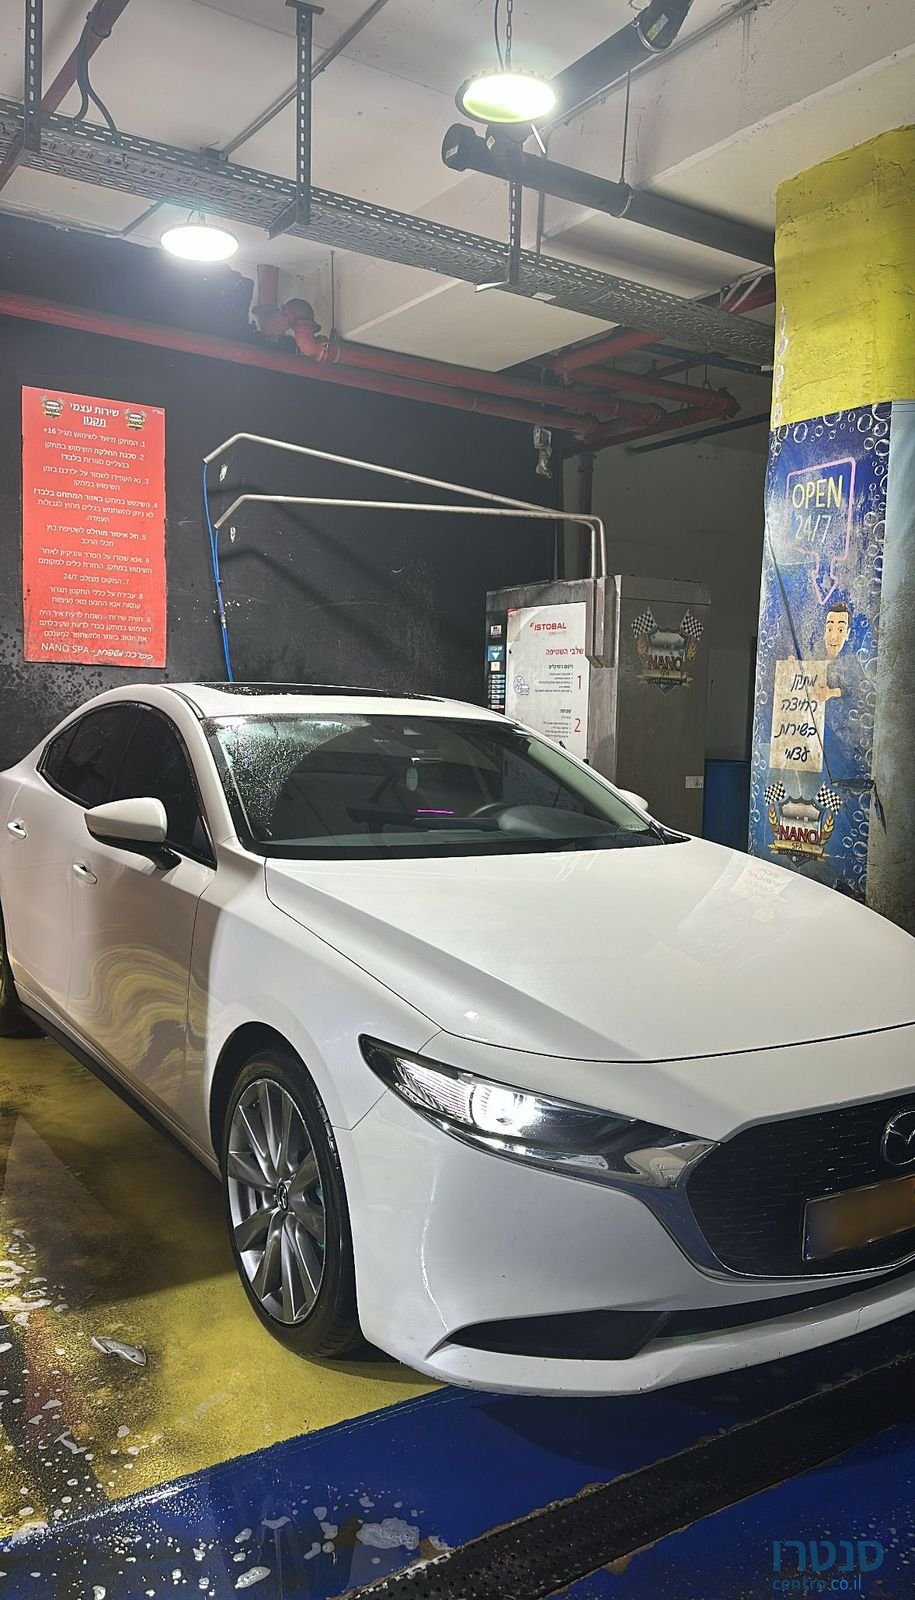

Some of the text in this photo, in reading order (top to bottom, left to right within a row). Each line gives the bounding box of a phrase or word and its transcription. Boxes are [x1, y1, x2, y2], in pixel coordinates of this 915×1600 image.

[792, 474, 843, 509] OPEN
[795, 514, 832, 543] 24/7
[534, 622, 567, 630] ISTOBAL
[649, 655, 682, 671] NANO
[577, 675, 581, 690] 1
[791, 674, 818, 692] מתקן
[781, 697, 818, 712] רחיצה
[574, 718, 581, 732] 2
[774, 723, 816, 738] בשירות
[785, 746, 810, 762] עצמי
[779, 825, 818, 845] NANO
